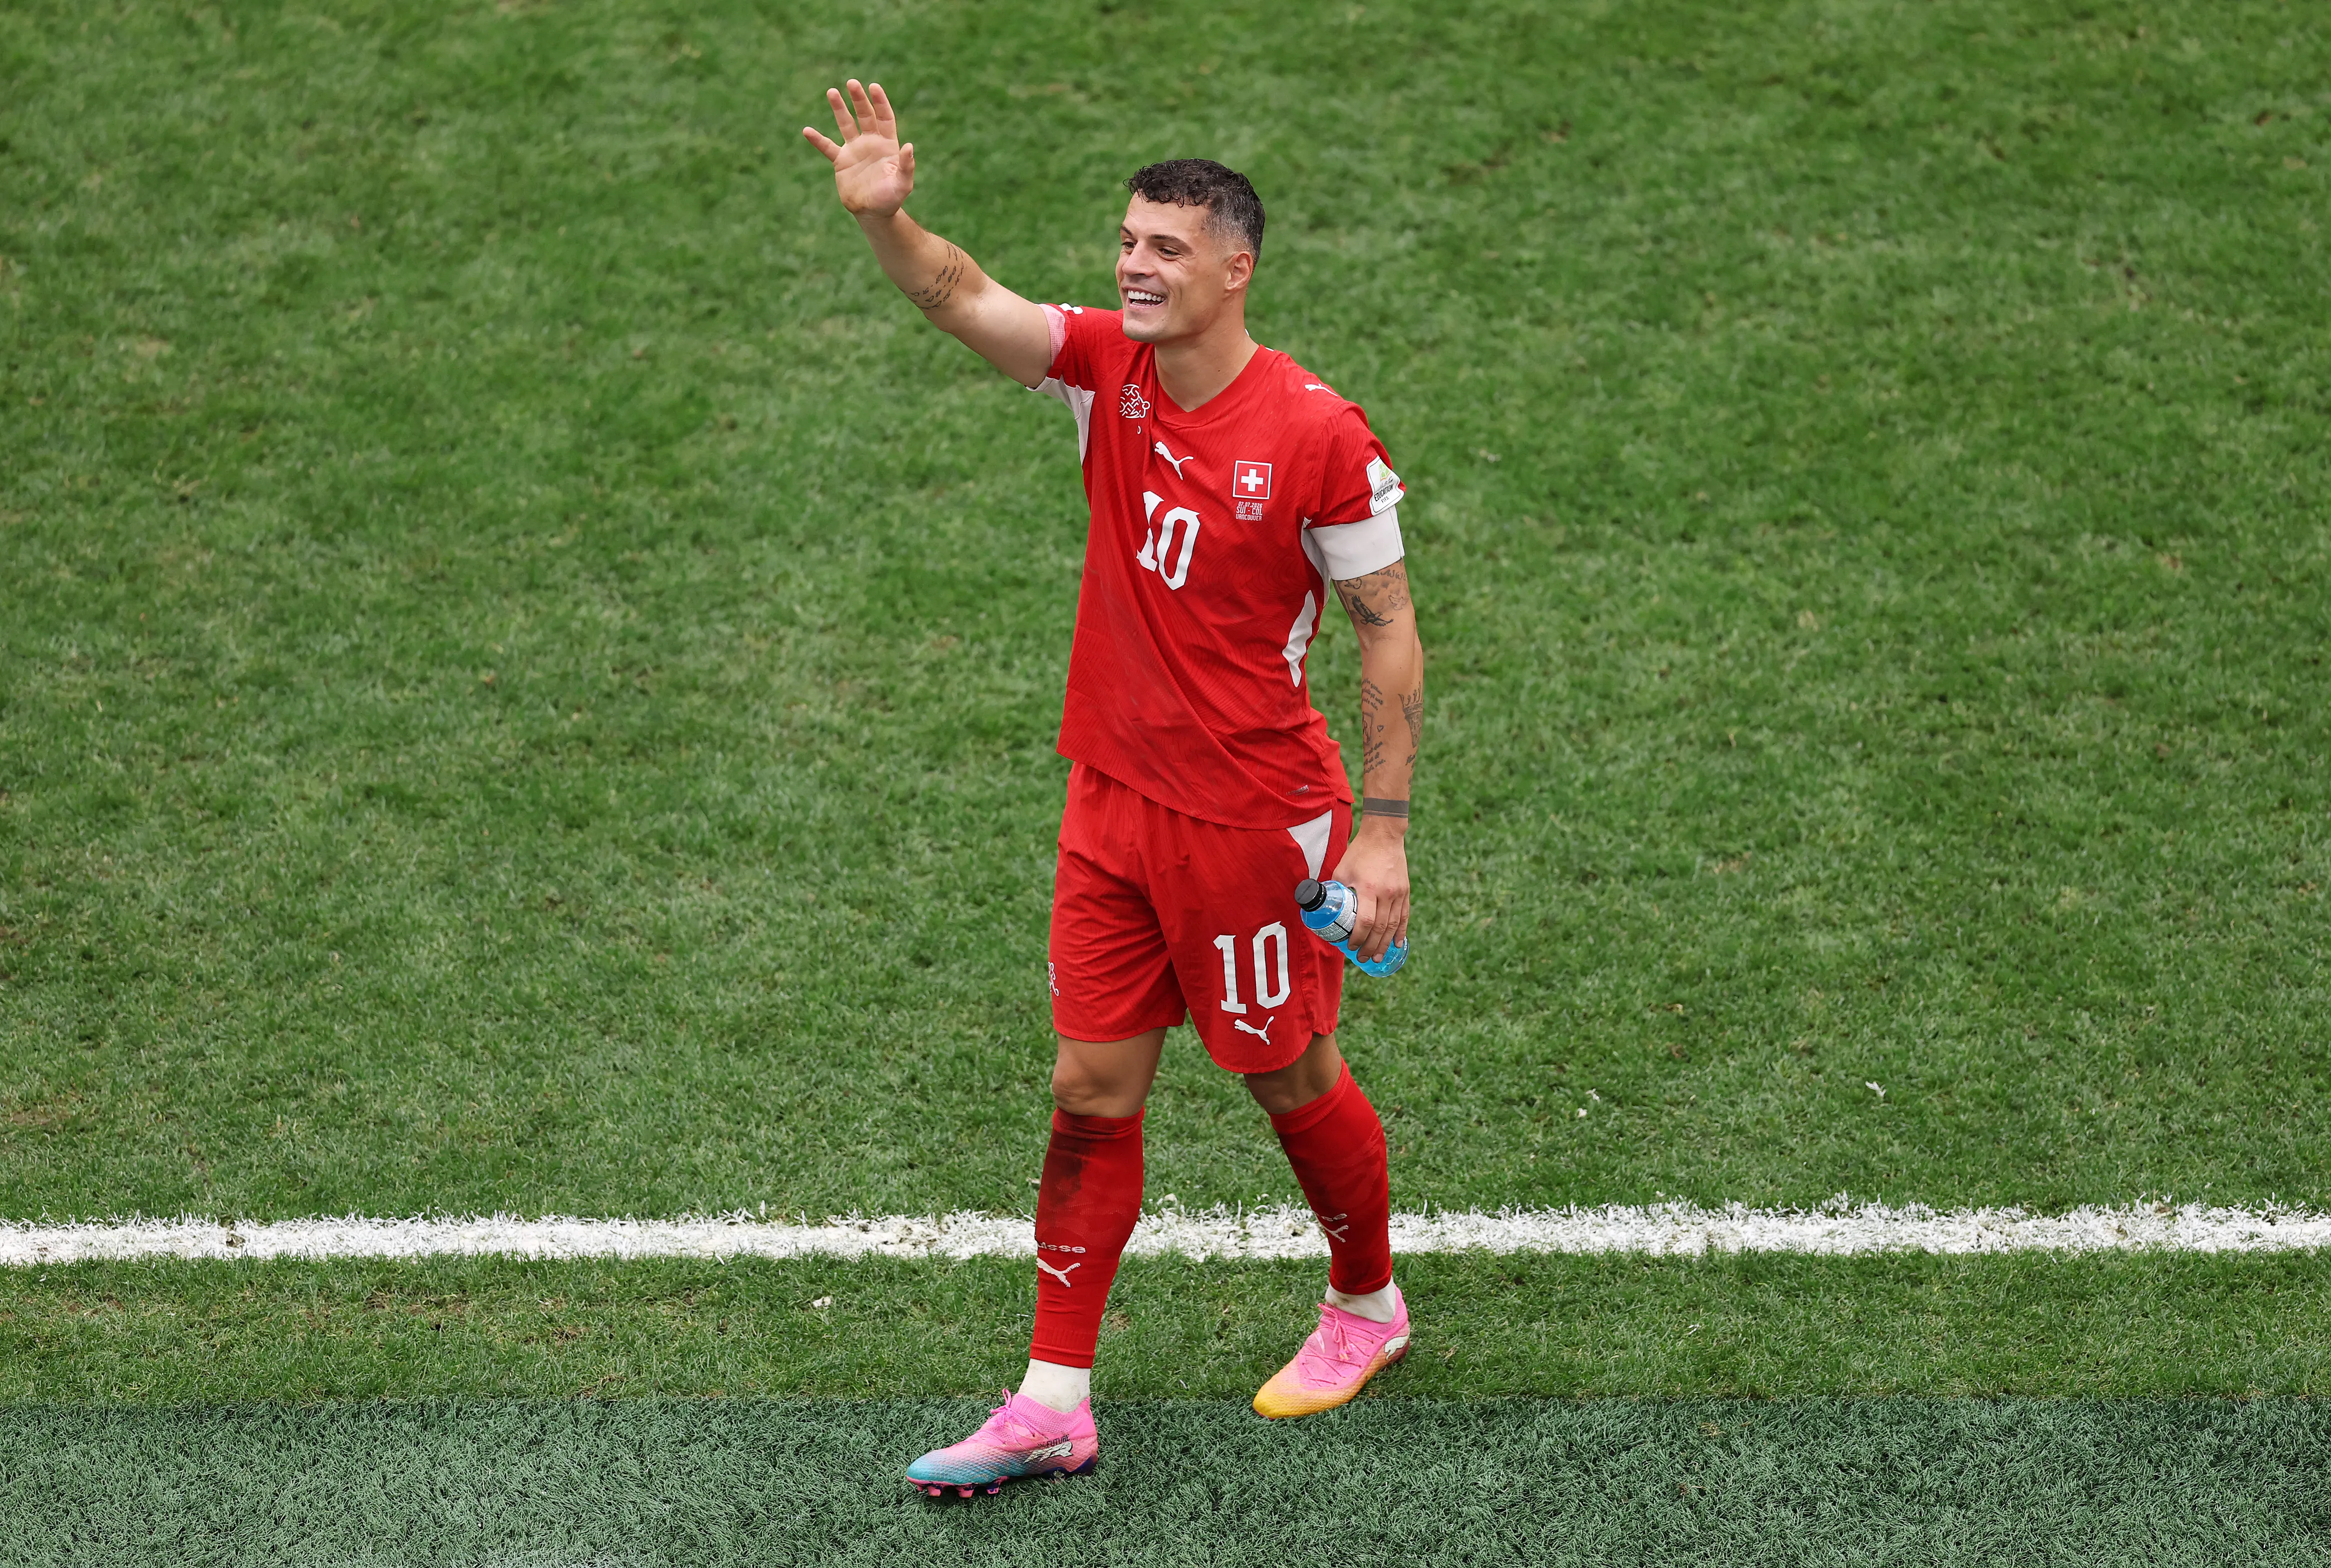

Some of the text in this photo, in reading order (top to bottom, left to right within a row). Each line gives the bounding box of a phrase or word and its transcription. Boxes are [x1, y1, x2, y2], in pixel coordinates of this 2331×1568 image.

[1374, 483, 1394, 502] EDUCATION
[1252, 508, 1263, 516] COL
[1136, 491, 1200, 590] 10
[1213, 921, 1291, 1014] 10
[1047, 1434, 1070, 1448] FUTURE
